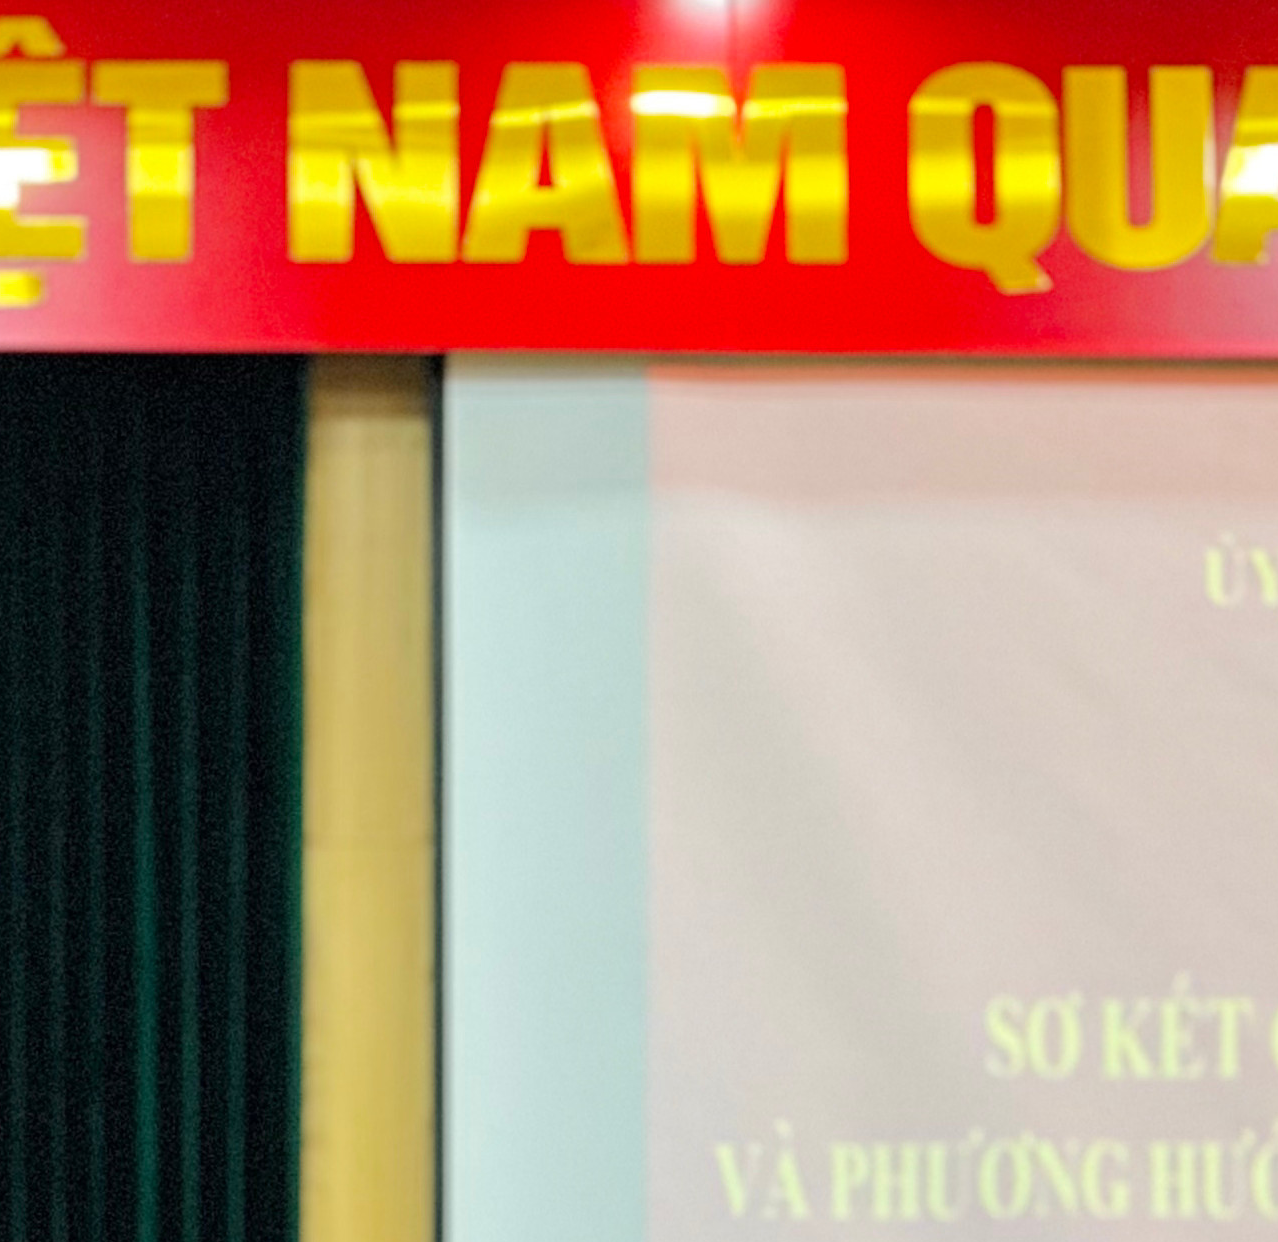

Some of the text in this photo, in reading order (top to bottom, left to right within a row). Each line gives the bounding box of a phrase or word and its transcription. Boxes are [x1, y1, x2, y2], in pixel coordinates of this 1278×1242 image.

[287, 60, 848, 265] NAM
[985, 990, 1087, 1076] SƠ
[714, 1117, 808, 1218] VÀ
[829, 1127, 1131, 1221] PHƯƠNG
